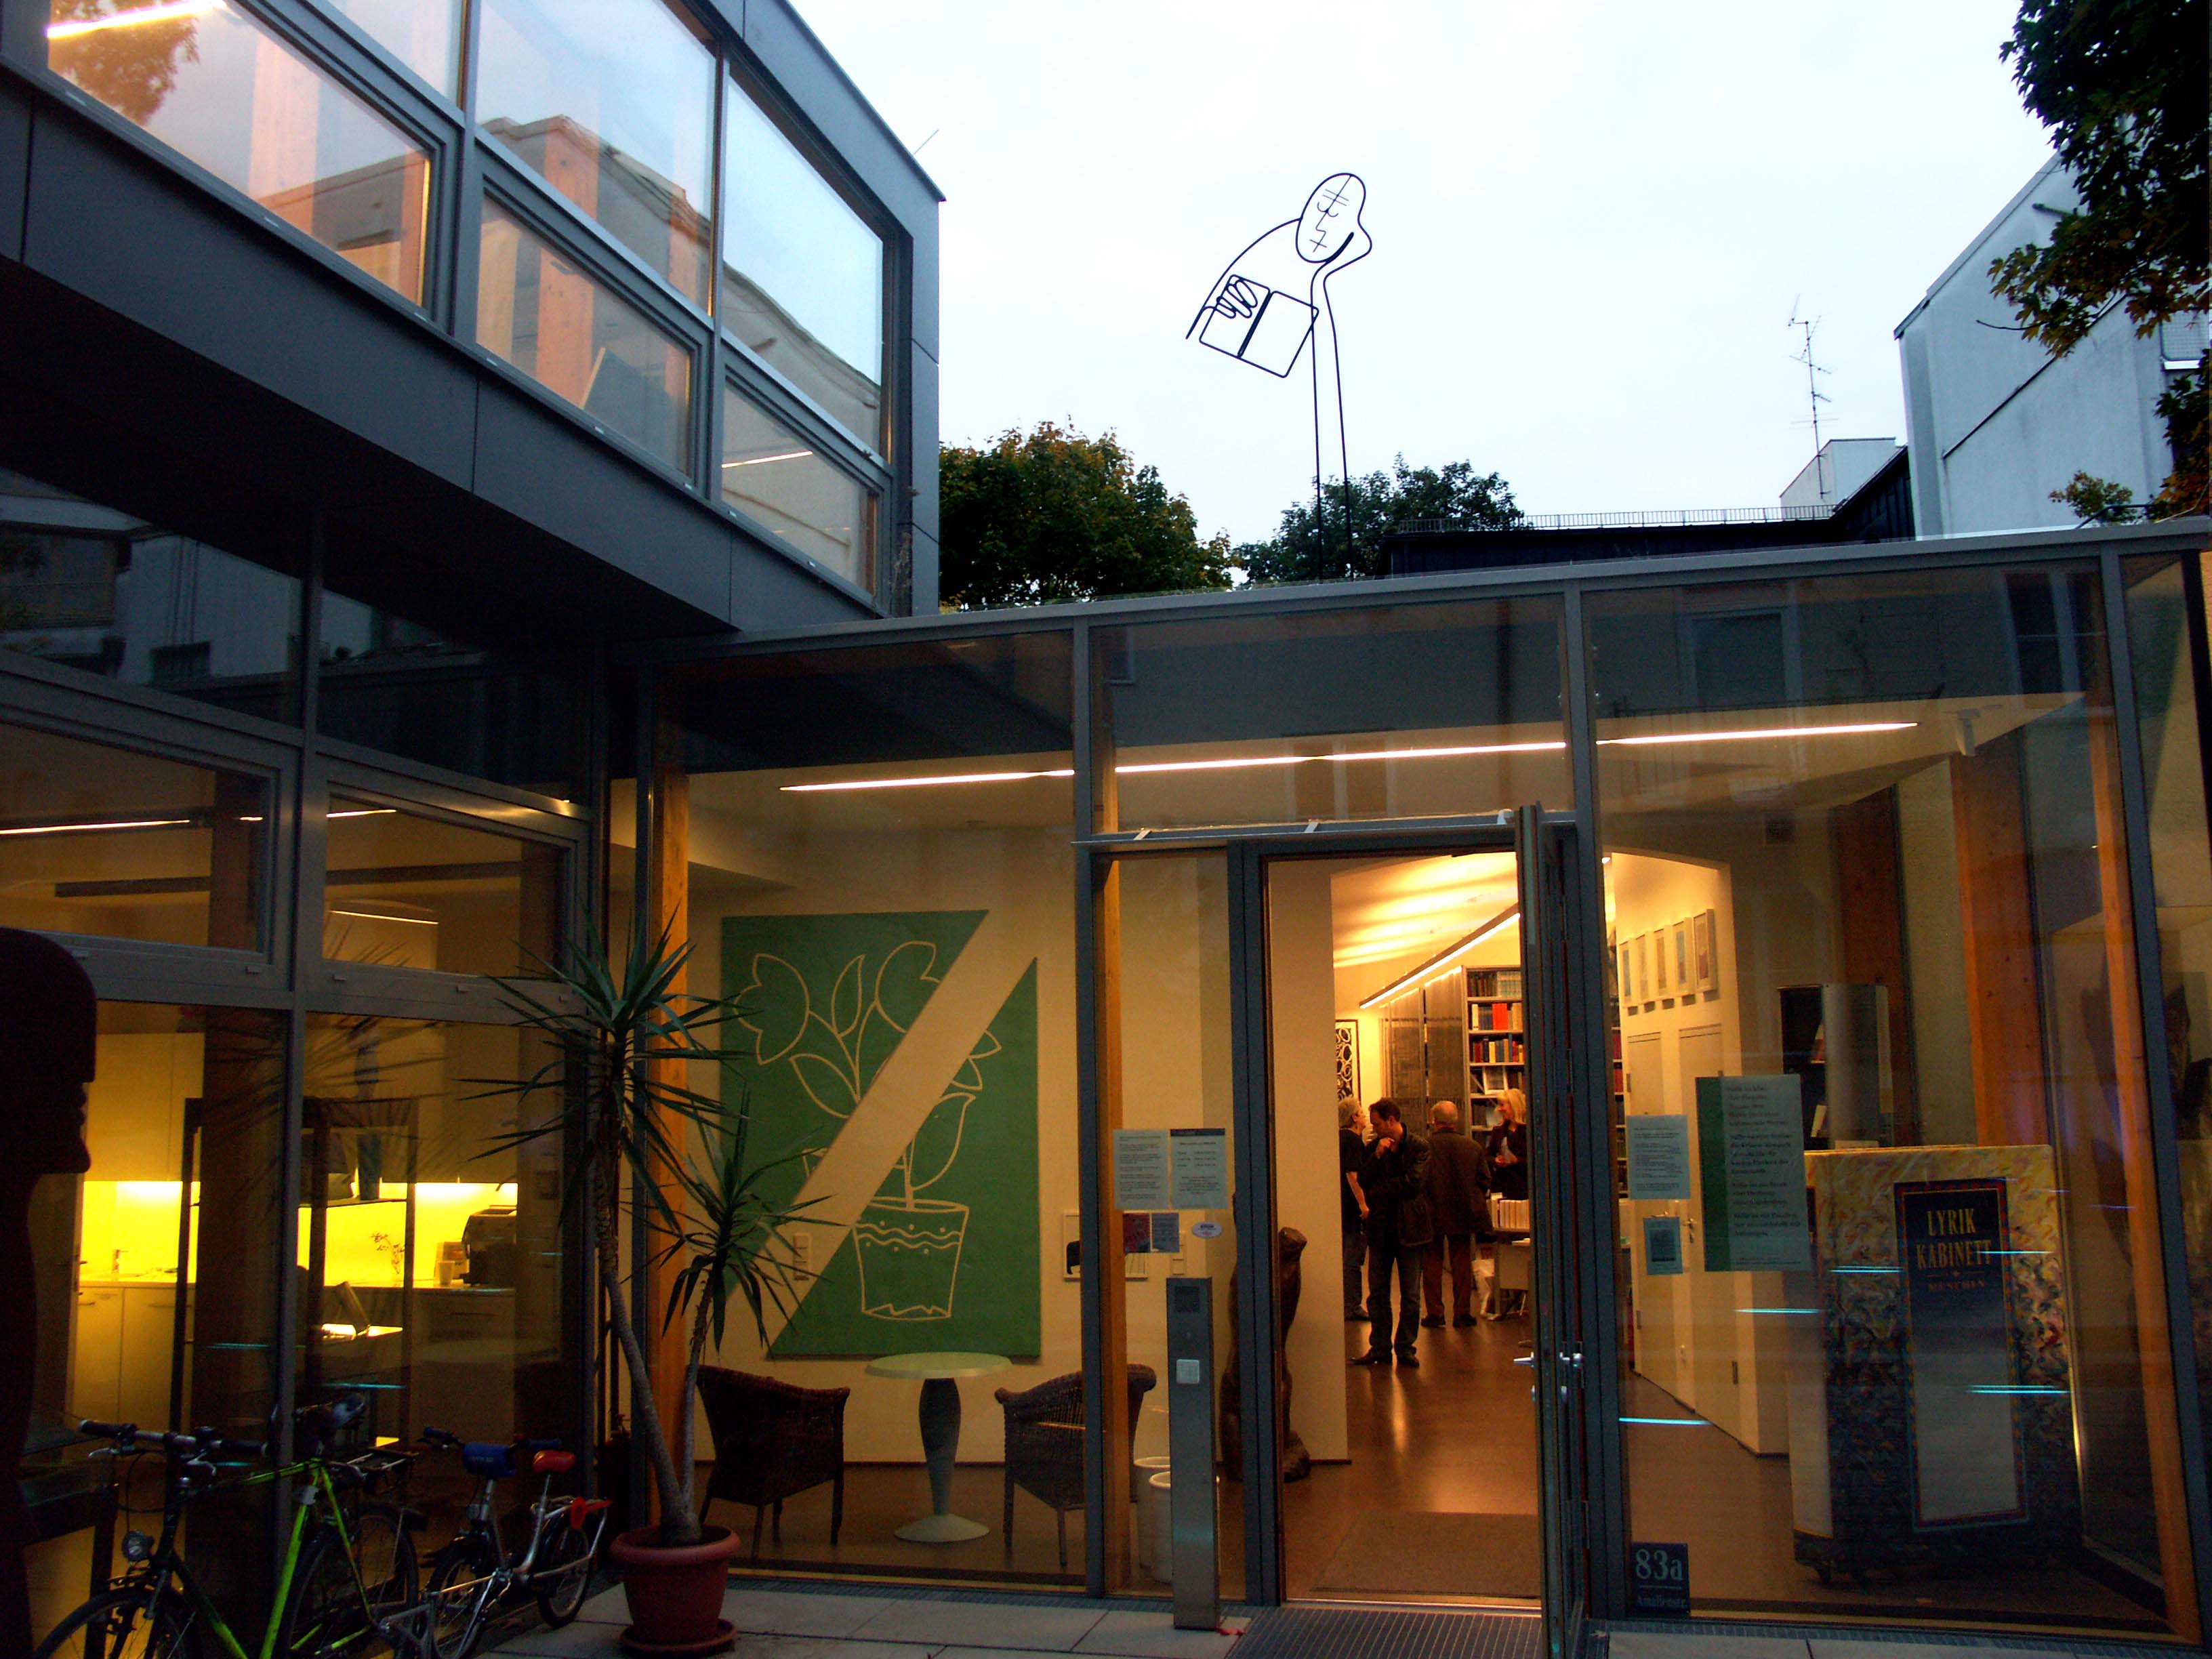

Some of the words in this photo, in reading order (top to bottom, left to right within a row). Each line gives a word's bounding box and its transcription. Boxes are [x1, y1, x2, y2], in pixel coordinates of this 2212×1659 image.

[1927, 1208, 1977, 1236] LYRIK
[1916, 1239, 1991, 1269] KABINETT
[1635, 1549, 1683, 1580] 83a
